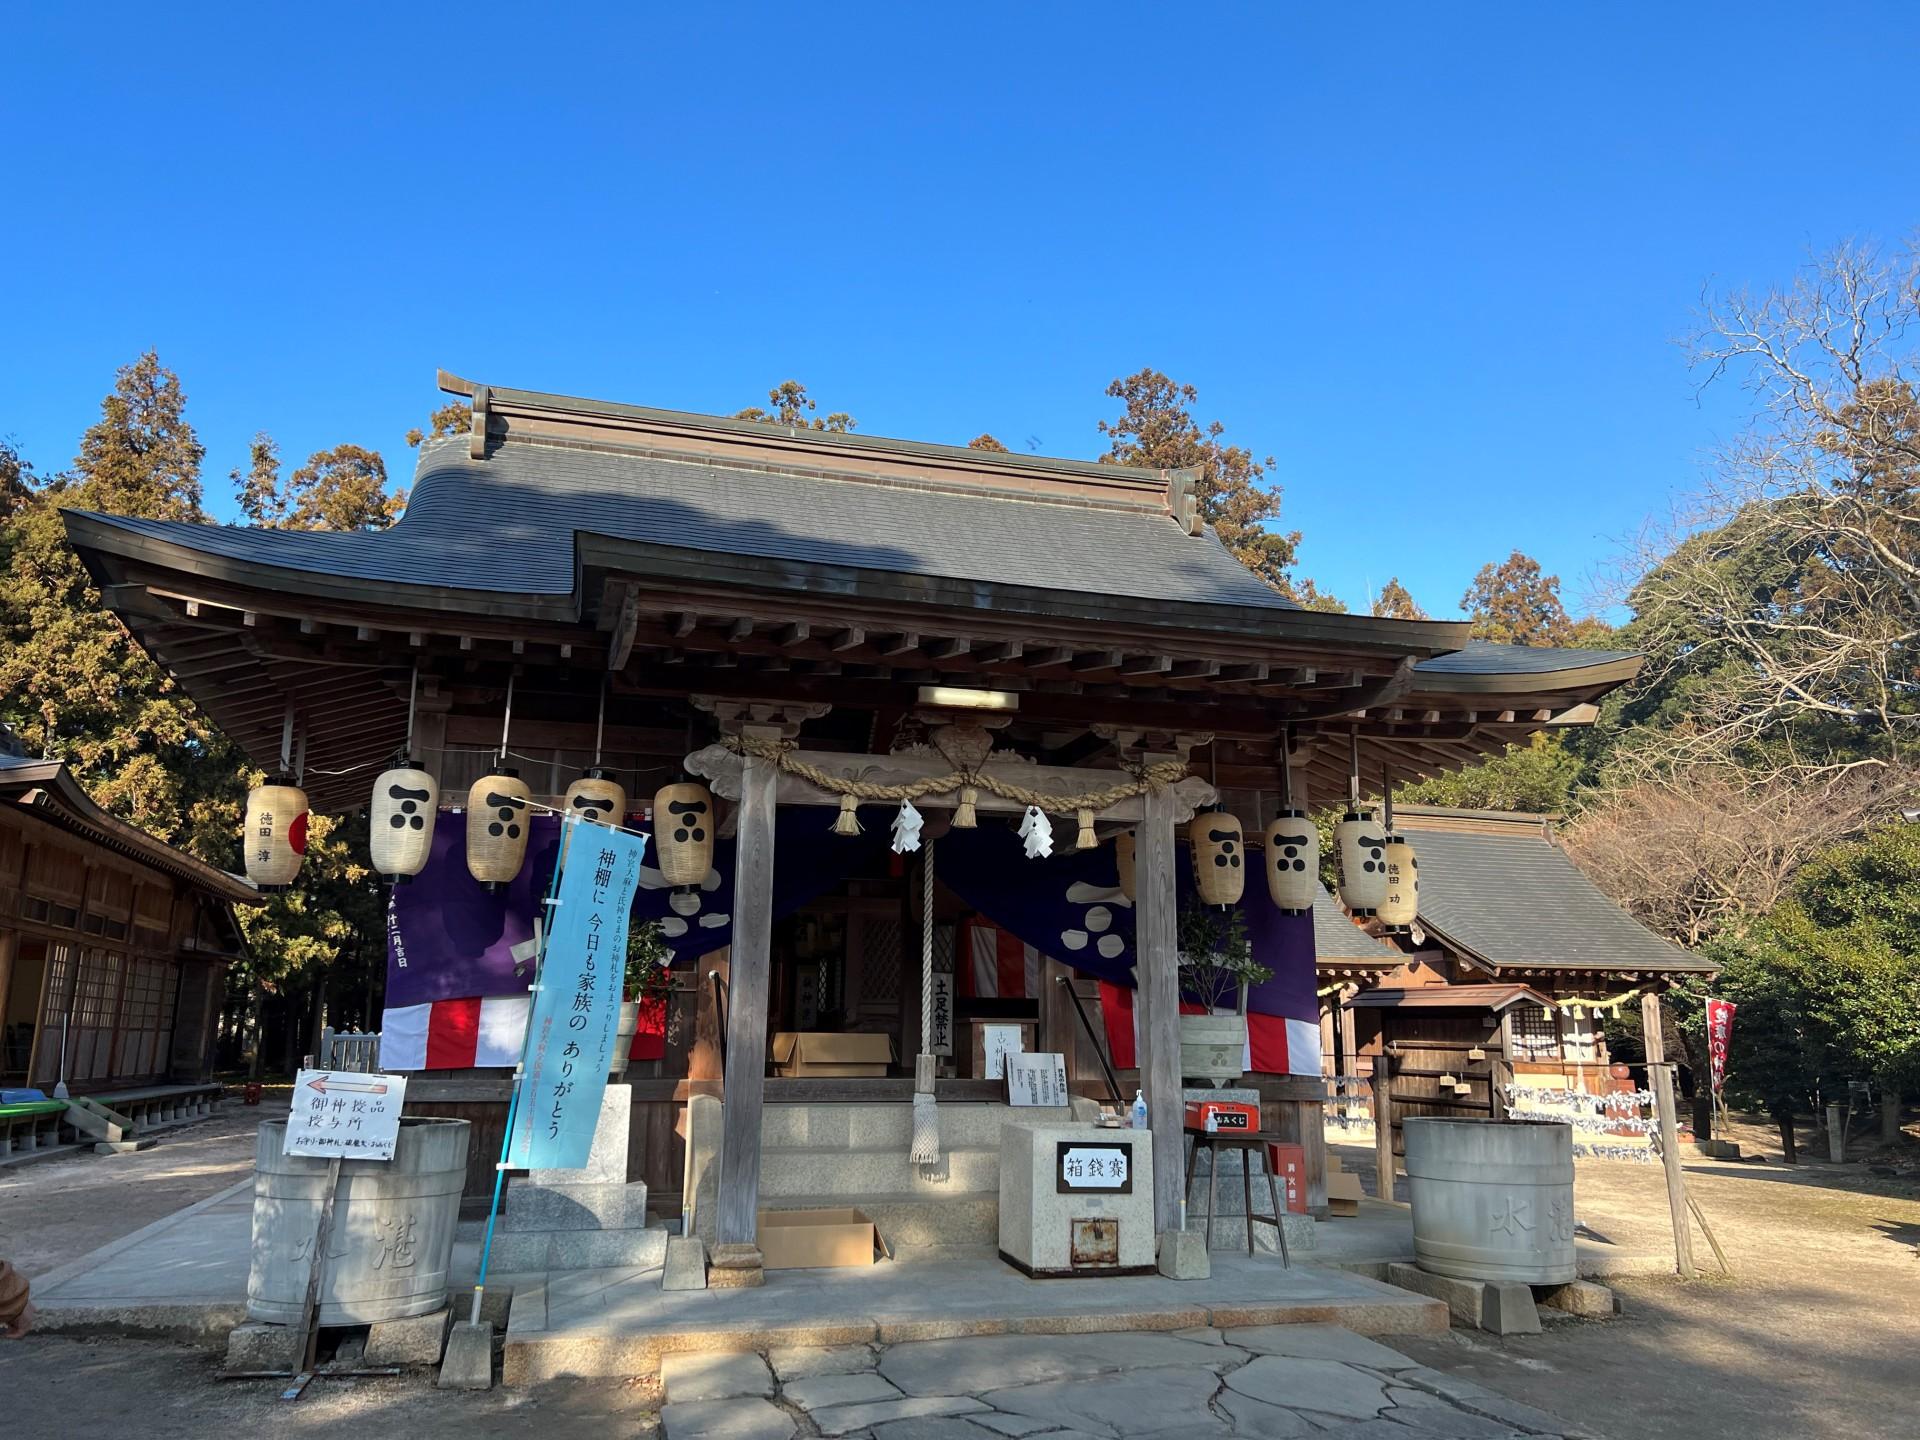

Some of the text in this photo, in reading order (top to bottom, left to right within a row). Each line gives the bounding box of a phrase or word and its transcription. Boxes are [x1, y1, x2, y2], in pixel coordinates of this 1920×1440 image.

[934, 979, 950, 1048] 土足禁止
[307, 1114, 362, 1130] 授与所
